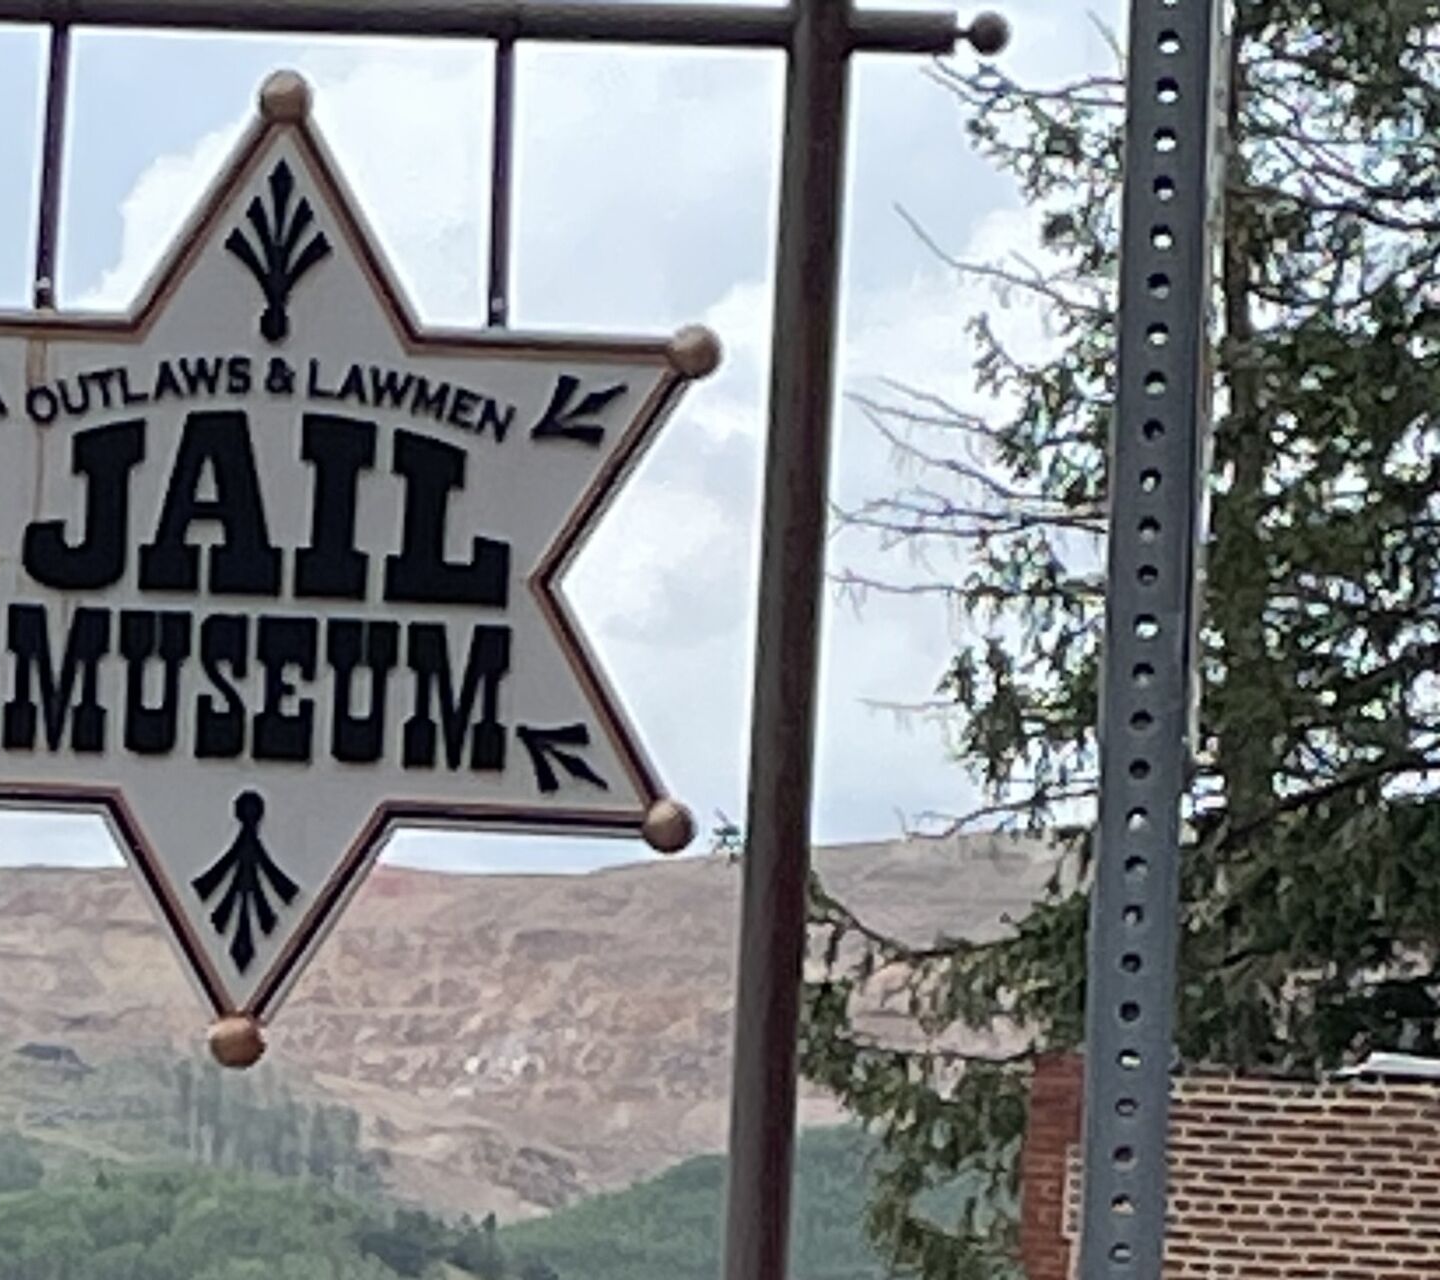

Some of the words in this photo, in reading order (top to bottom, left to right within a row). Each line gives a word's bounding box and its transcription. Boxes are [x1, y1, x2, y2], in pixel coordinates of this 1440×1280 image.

[24, 356, 253, 426] OUTLAWS
[263, 356, 297, 396] &
[307, 357, 517, 444] LAWMEN
[20, 409, 512, 612] JAIL
[0, 602, 514, 775] MUSEUM
